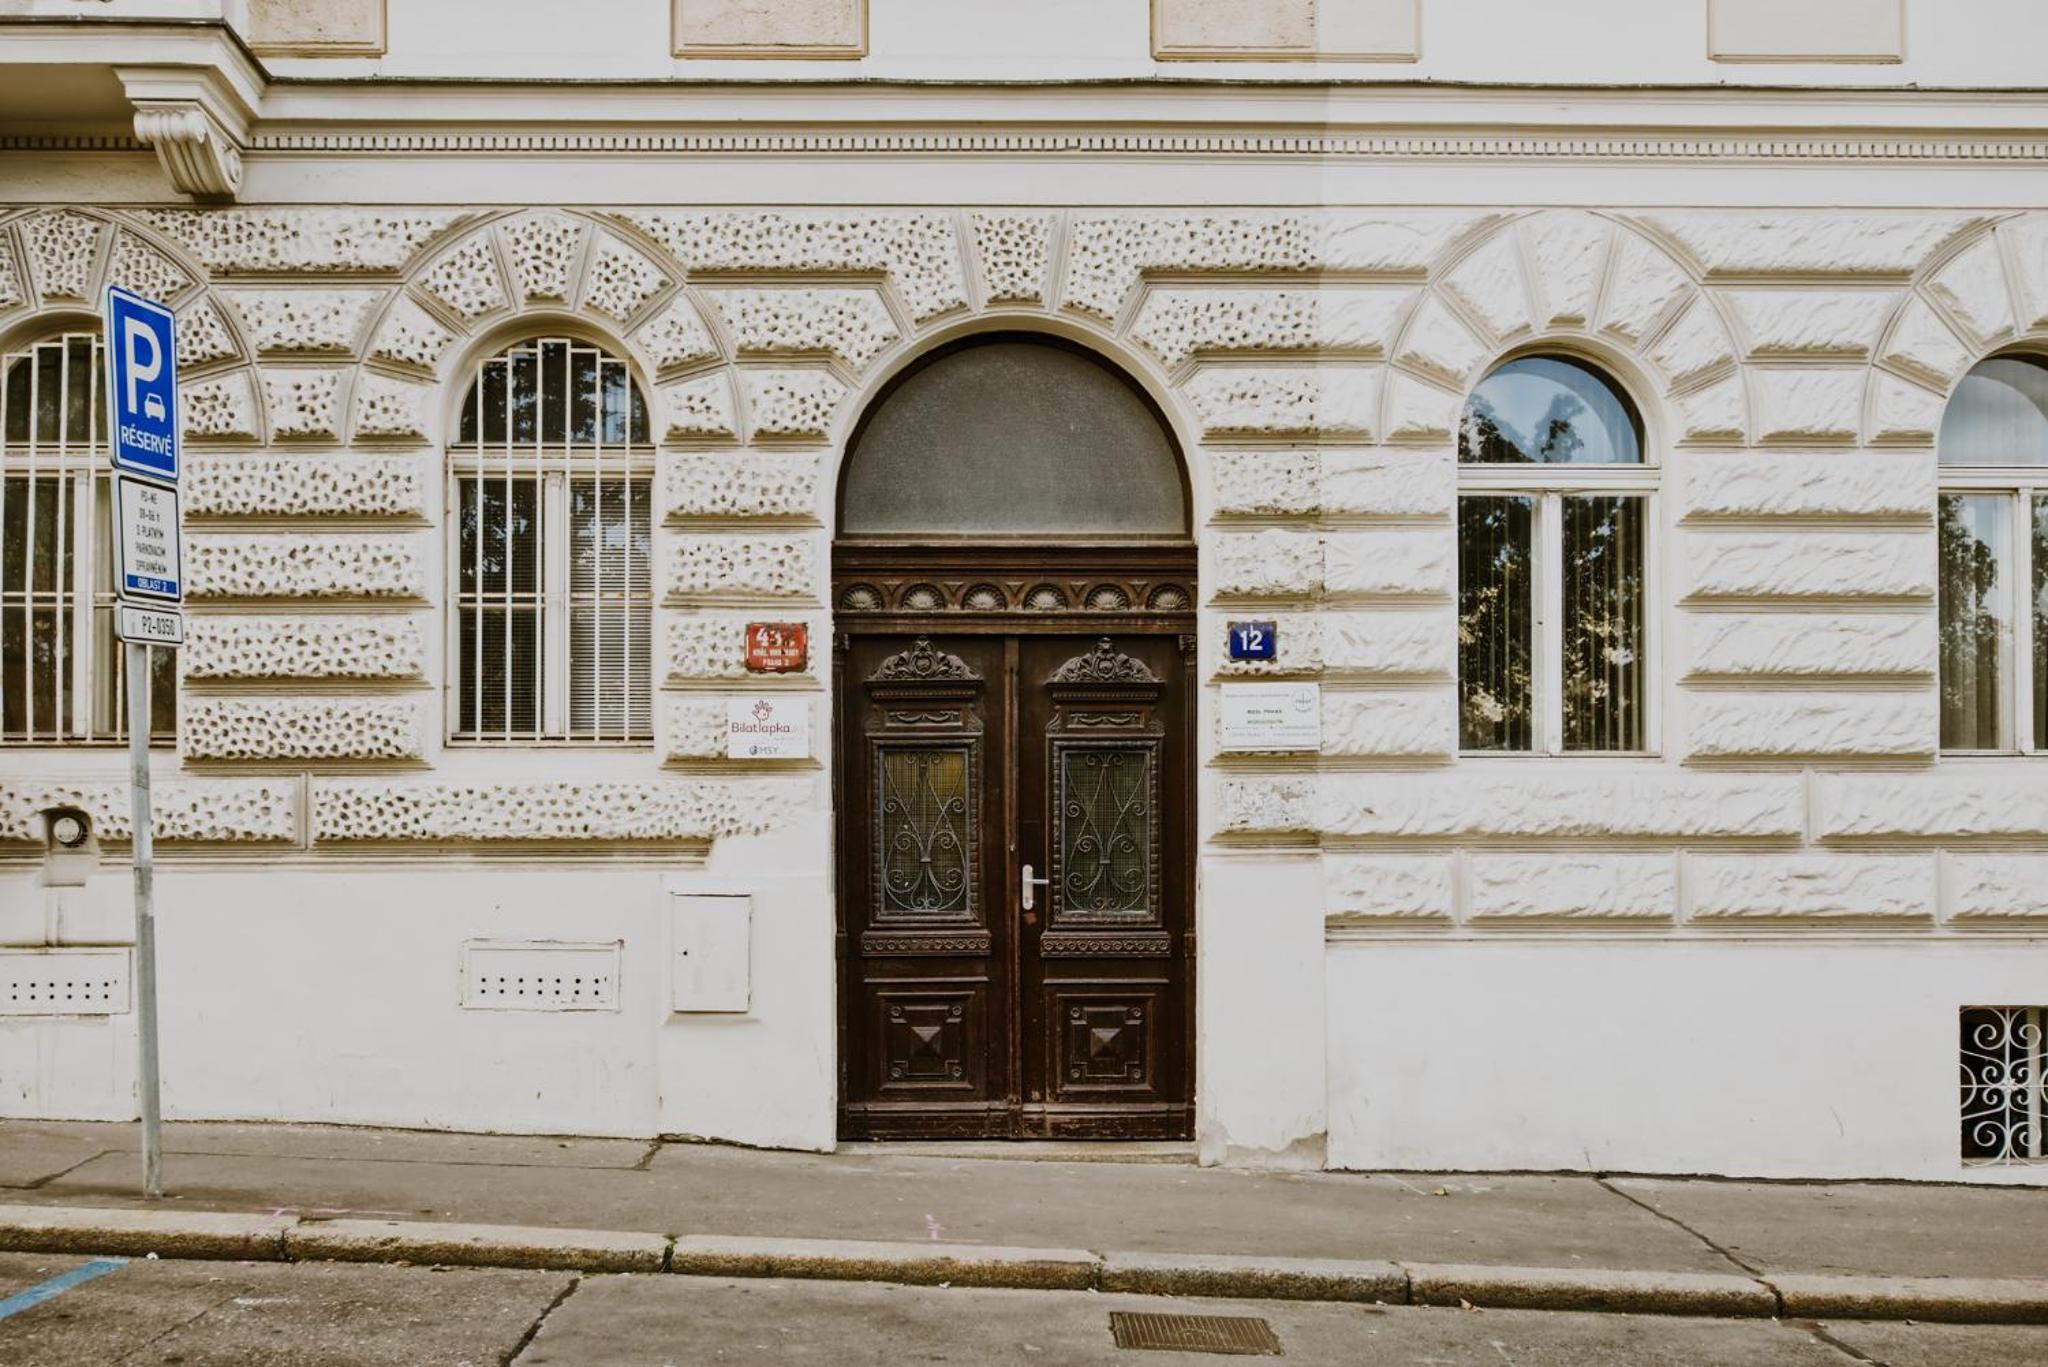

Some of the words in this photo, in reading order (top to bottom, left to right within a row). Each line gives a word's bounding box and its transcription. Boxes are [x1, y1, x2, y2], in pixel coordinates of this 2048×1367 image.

[124, 316, 162, 415] P
[120, 424, 173, 457] RÉSERVÉ
[1240, 628, 1264, 651] 12
